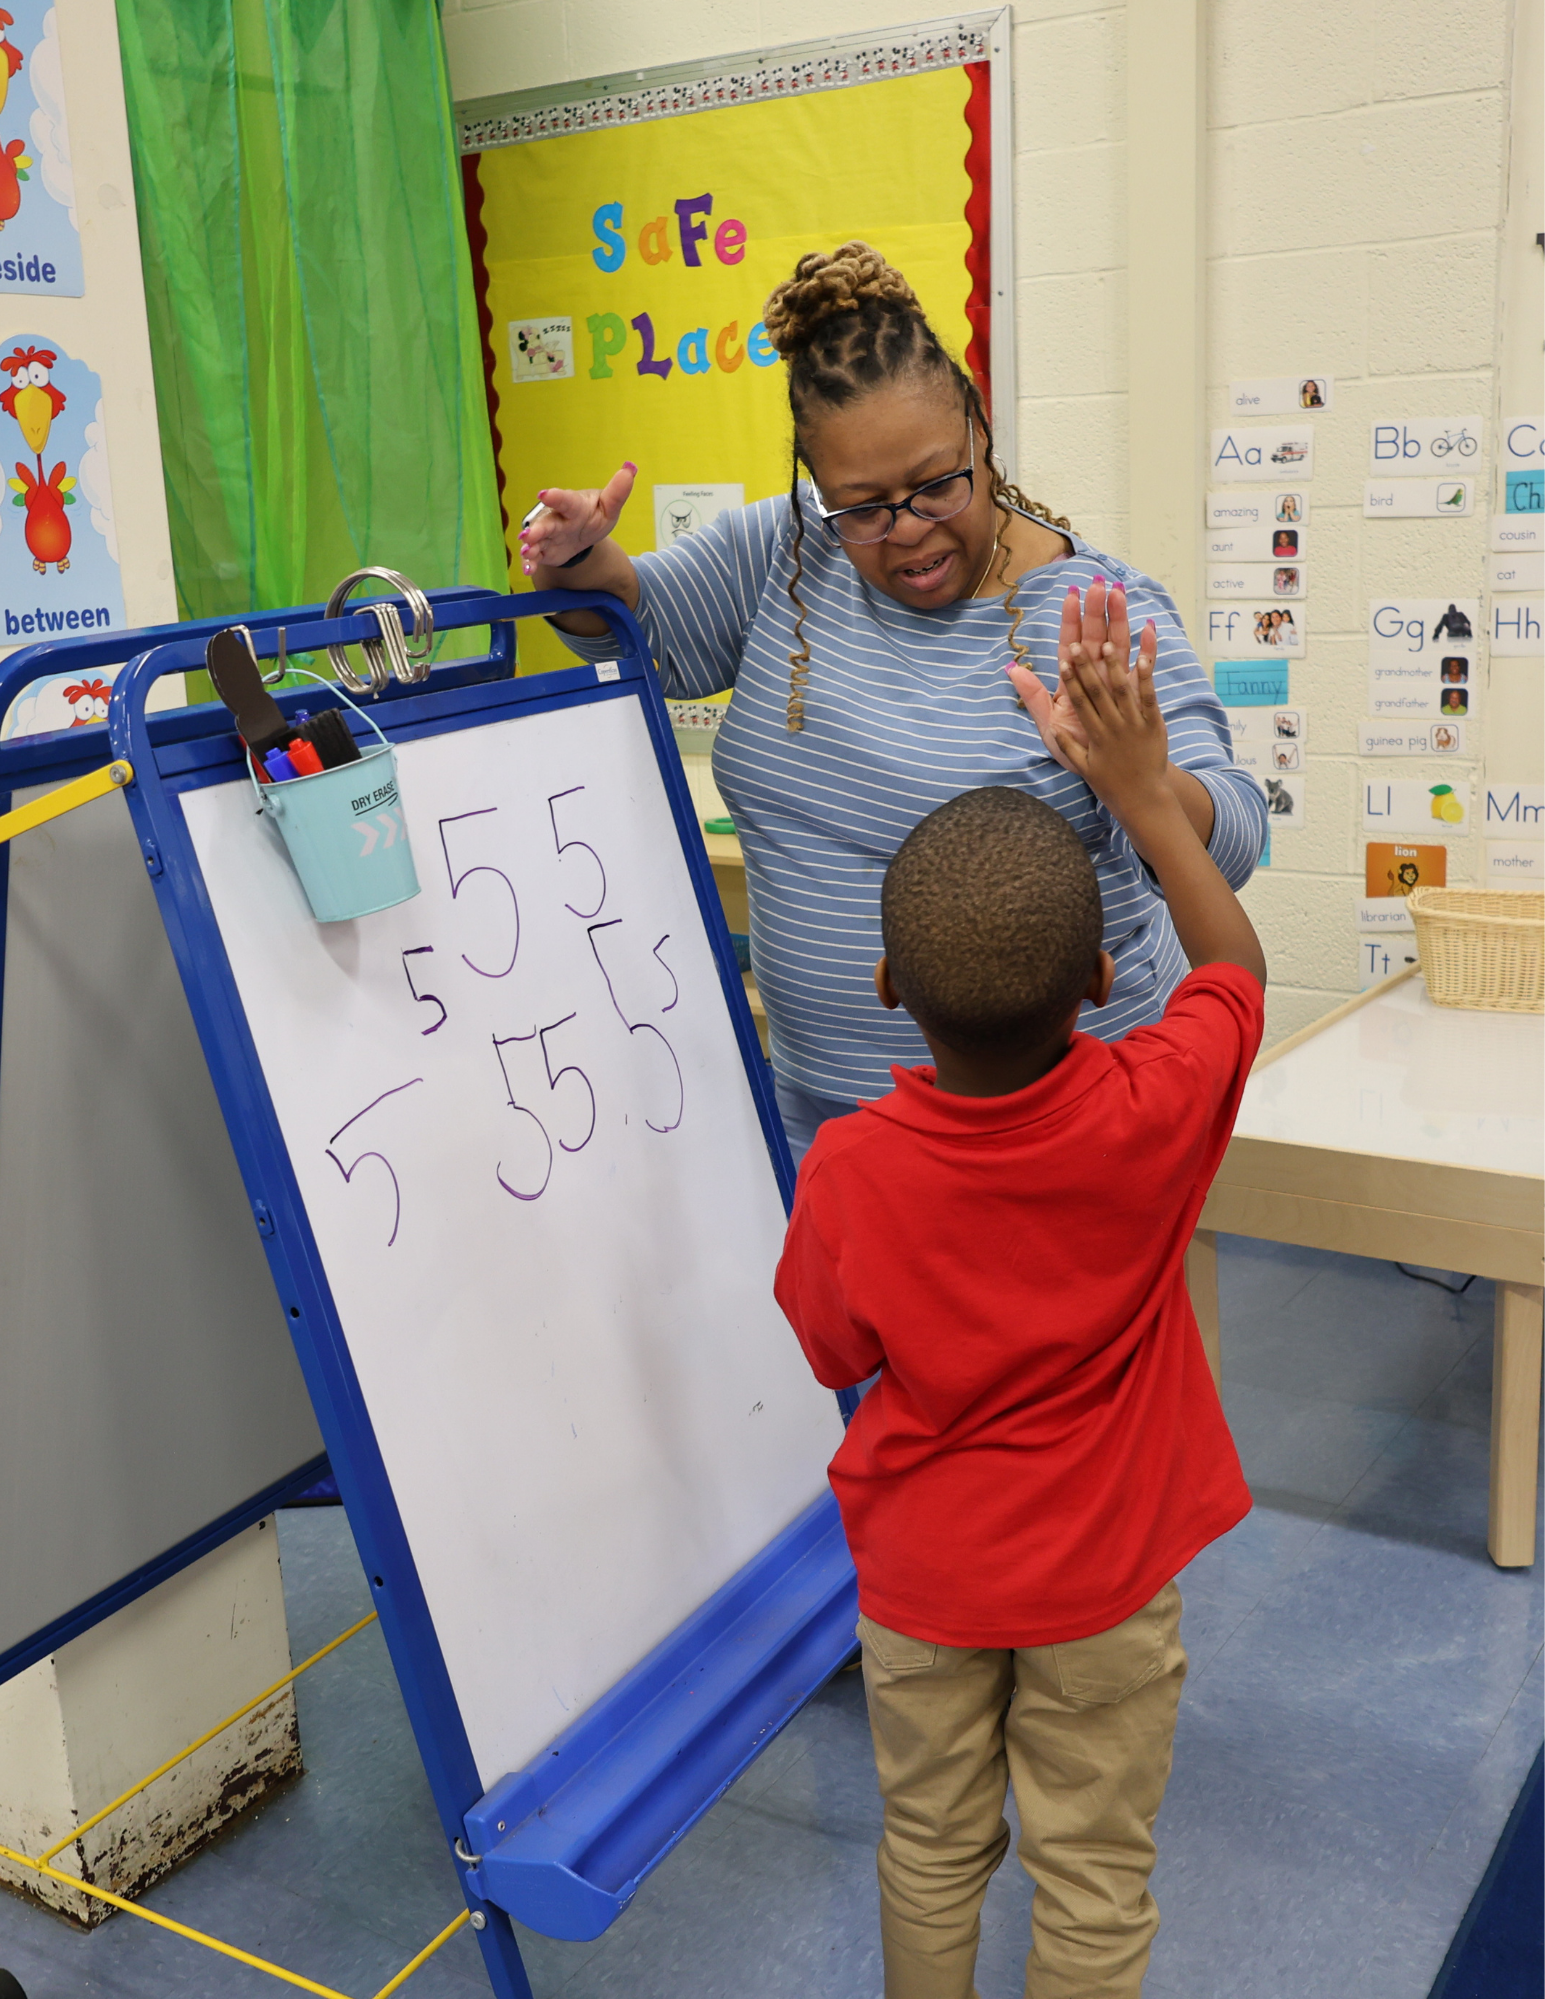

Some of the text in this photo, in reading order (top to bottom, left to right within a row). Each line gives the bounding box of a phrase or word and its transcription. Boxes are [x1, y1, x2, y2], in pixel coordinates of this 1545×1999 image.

[1235, 393, 1260, 405] alive
[1374, 426, 1421, 459] Bb
[1214, 435, 1262, 466] Aa
[1370, 493, 1393, 506] bird
[1213, 508, 1259, 522] amazing
[1499, 531, 1536, 541] cousin
[1212, 543, 1233, 552] aunt
[1497, 570, 1516, 580] cat
[1213, 579, 1244, 589] active
[5, 607, 110, 636] between
[1209, 611, 1241, 641] Ff
[1373, 606, 1424, 652] Gg
[1495, 607, 1540, 639] Hh
[1375, 668, 1433, 680] grandmother
[1375, 698, 1429, 711] grandfather
[1366, 735, 1427, 750] guinea pig
[351, 781, 395, 811] DRY ERASE
[548, 786, 606, 918] 5
[1394, 845, 1417, 857] lion
[1493, 856, 1534, 867] mother
[439, 807, 520, 978] 5
[1361, 911, 1406, 922] librarian
[1364, 944, 1390, 975] Tt
[402, 945, 448, 1036] 5
[324, 1077, 424, 1247] 5
